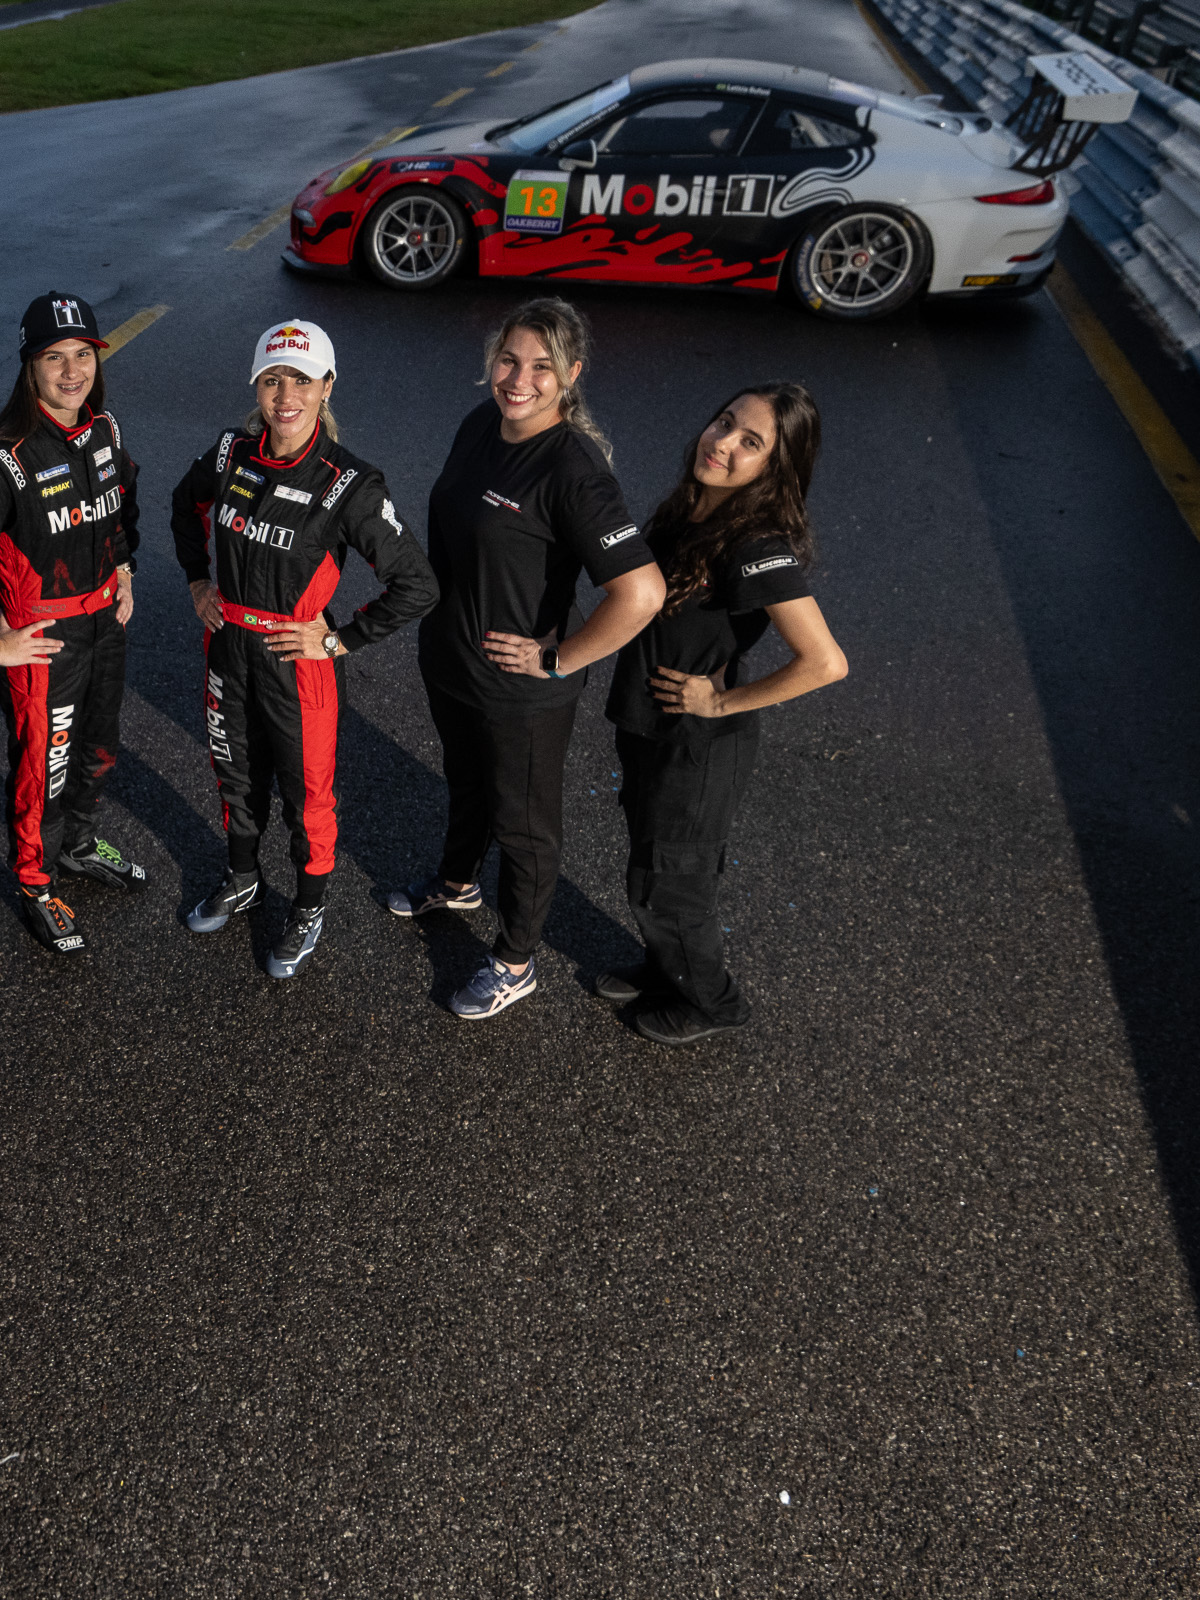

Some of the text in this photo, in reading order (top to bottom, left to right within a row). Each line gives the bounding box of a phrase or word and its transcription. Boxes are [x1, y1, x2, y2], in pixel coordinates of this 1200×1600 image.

[521, 187, 558, 217] 13
[580, 174, 717, 216] Mobil
[507, 218, 559, 229] OAKBERRY
[52, 299, 78, 308] Mobil
[62, 307, 74, 324] 1
[266, 339, 309, 354] Red Bull
[216, 432, 234, 472] sparco
[322, 469, 355, 508] sparco
[48, 495, 107, 534] Mobil
[218, 503, 270, 544] Mobil
[32, 604, 67, 614] sparco
[207, 668, 226, 740] Mobil
[49, 704, 74, 773] Mobil
[58, 937, 84, 951] OMP
